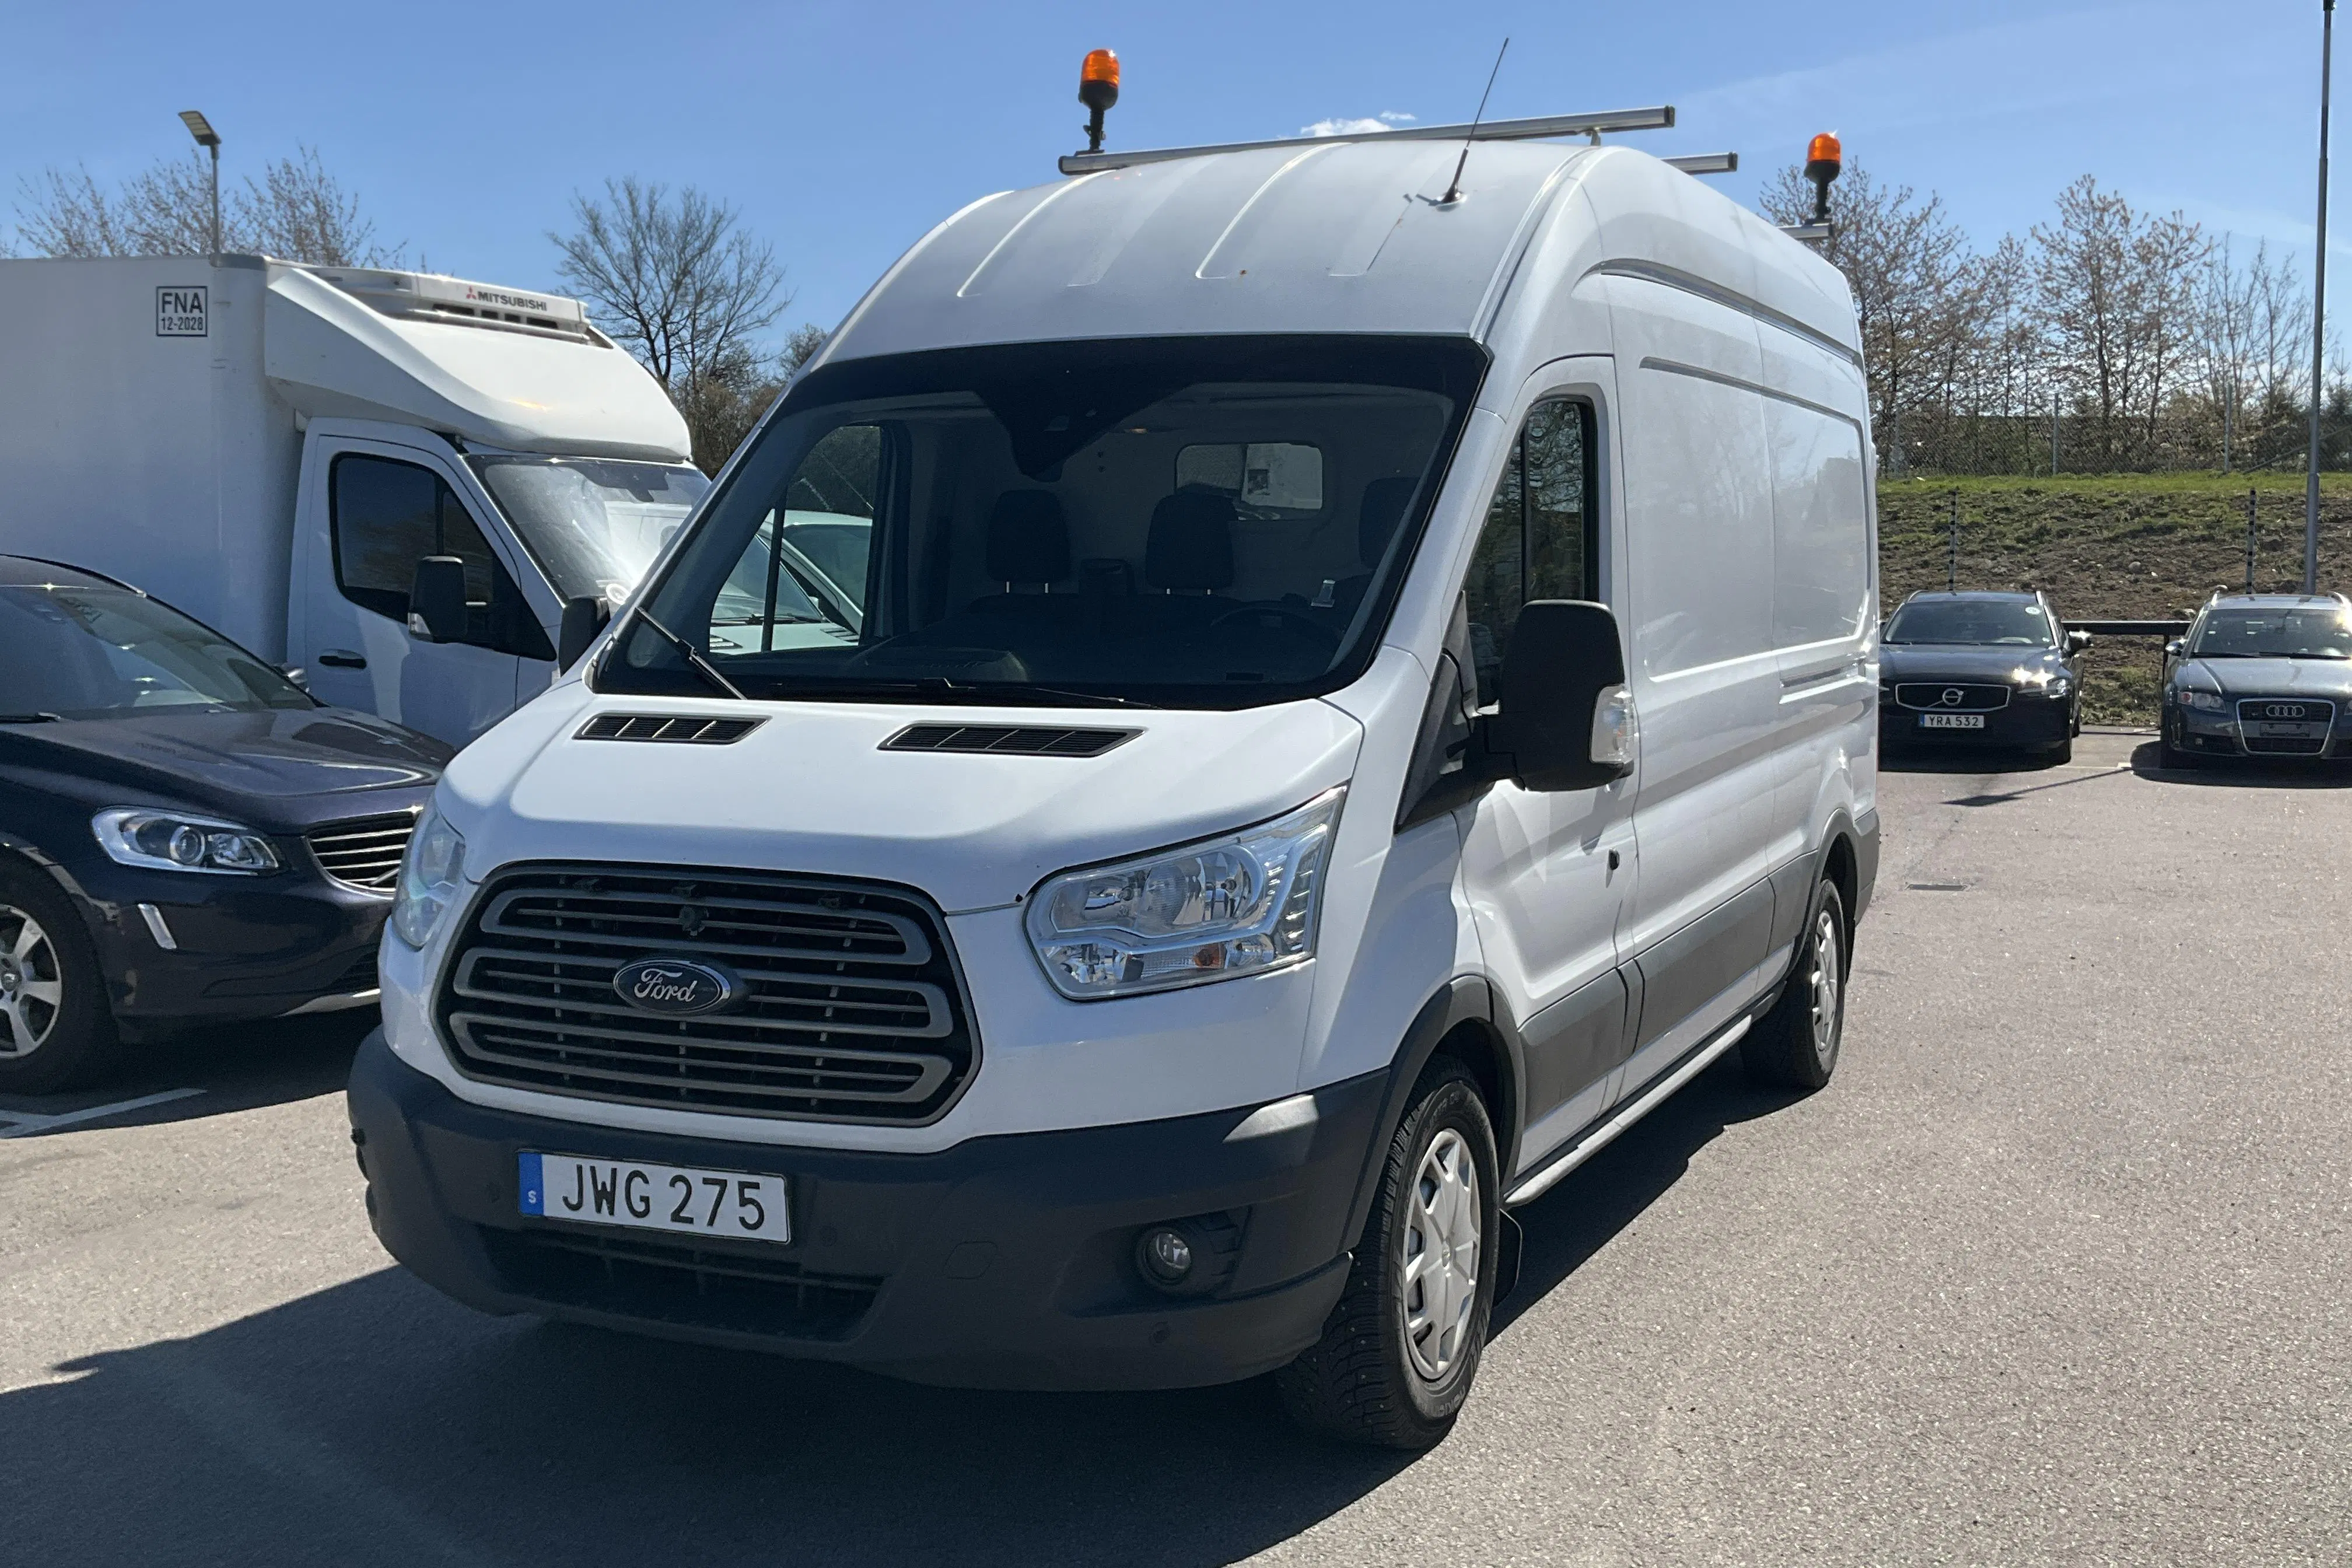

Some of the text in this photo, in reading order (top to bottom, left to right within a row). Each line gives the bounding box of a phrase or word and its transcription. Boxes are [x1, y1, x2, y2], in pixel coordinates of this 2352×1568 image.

[162, 292, 203, 313] FNA
[477, 291, 547, 311] MITSUBISHI
[161, 316, 203, 331] 12-2028
[1929, 716, 1979, 727] YRA 532
[634, 968, 698, 1002] Ford
[527, 1164, 765, 1230] S JWG 275
